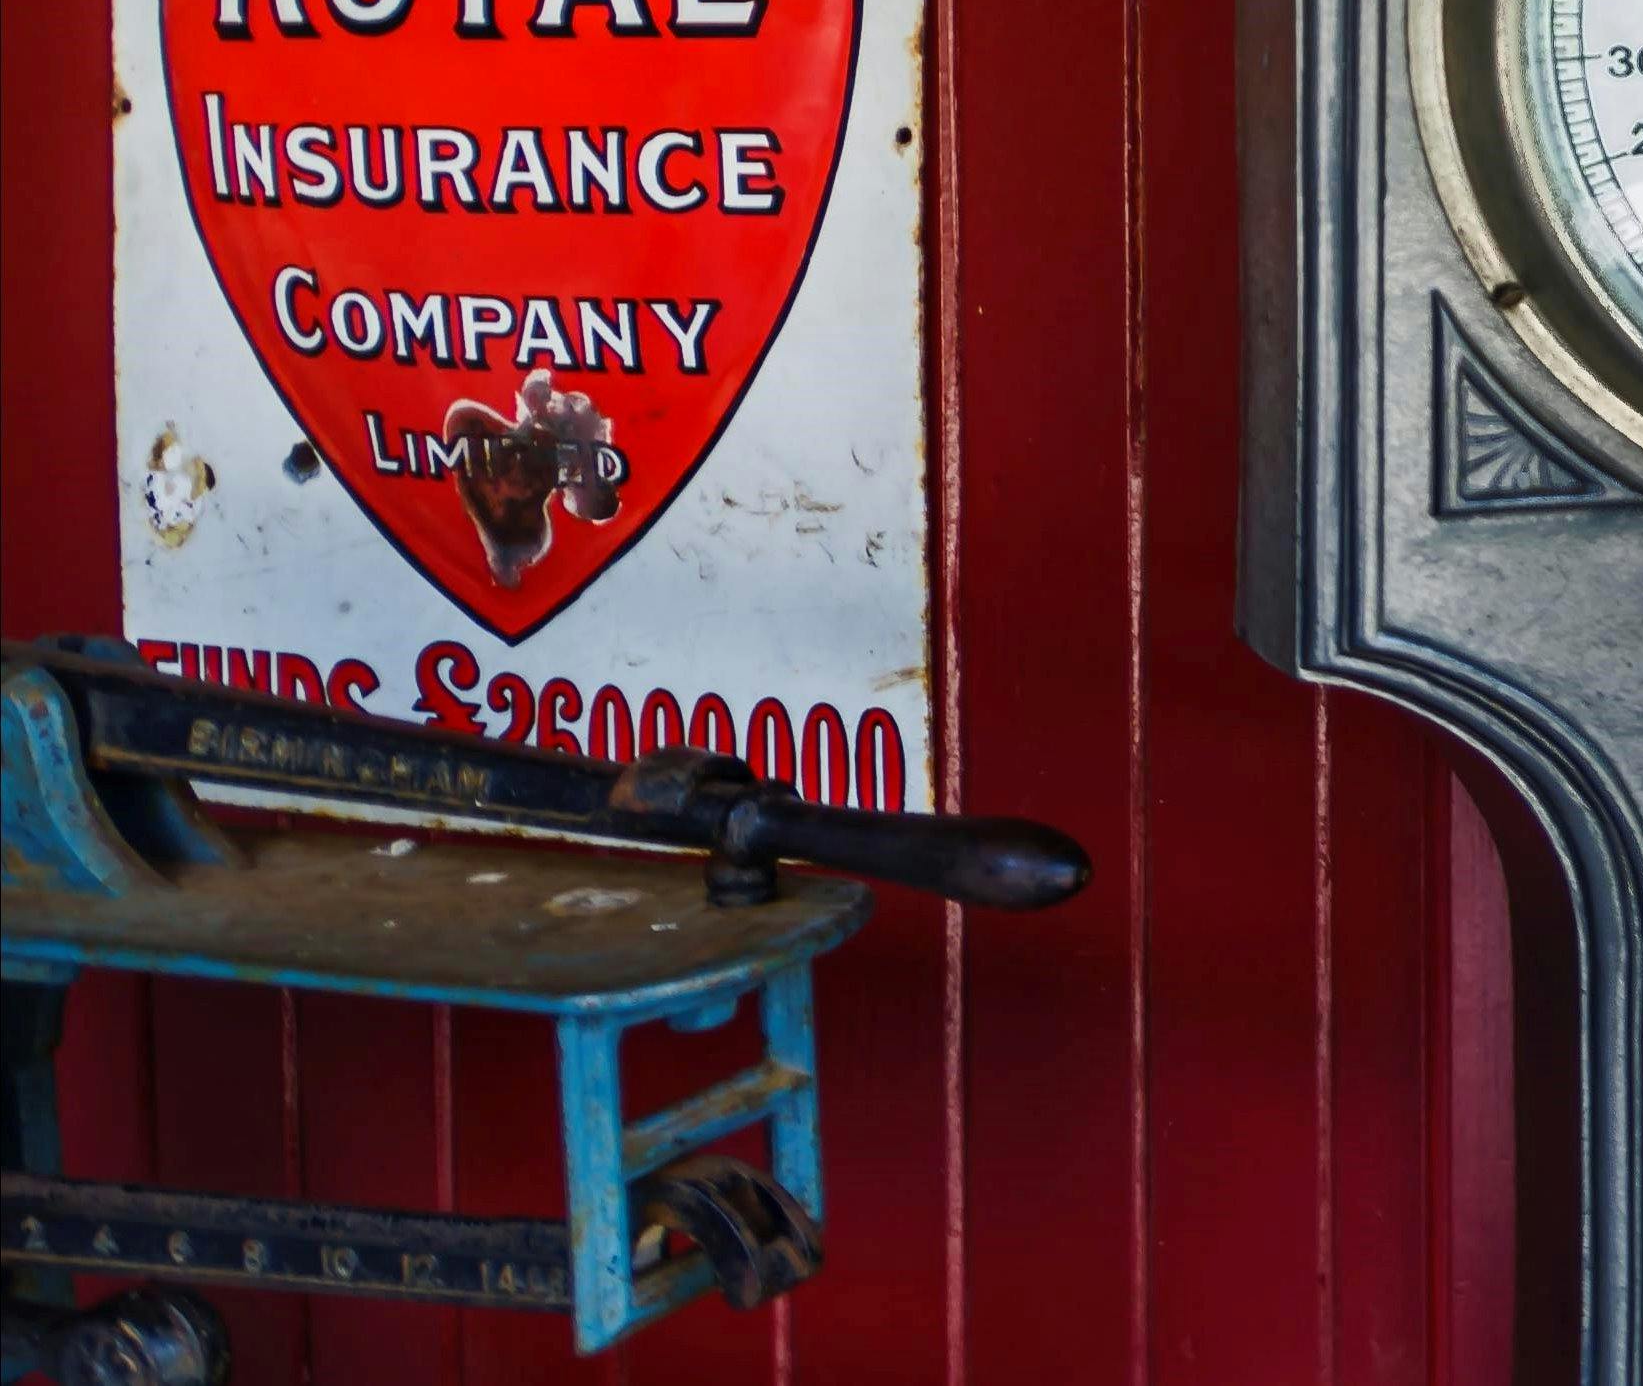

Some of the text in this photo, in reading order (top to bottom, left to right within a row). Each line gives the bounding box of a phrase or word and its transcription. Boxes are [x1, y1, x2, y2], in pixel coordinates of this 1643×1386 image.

[203, 91, 785, 215] INSURANCE
[272, 264, 722, 375] COMPANY
[363, 410, 630, 488] LIMIED
[188, 718, 493, 803] BIRMINGHAM
[20, 1214, 47, 1251] 2
[166, 1230, 195, 1264] 6
[242, 1238, 267, 1276] 8
[320, 1245, 358, 1282] 10
[402, 1253, 445, 1290] 12
